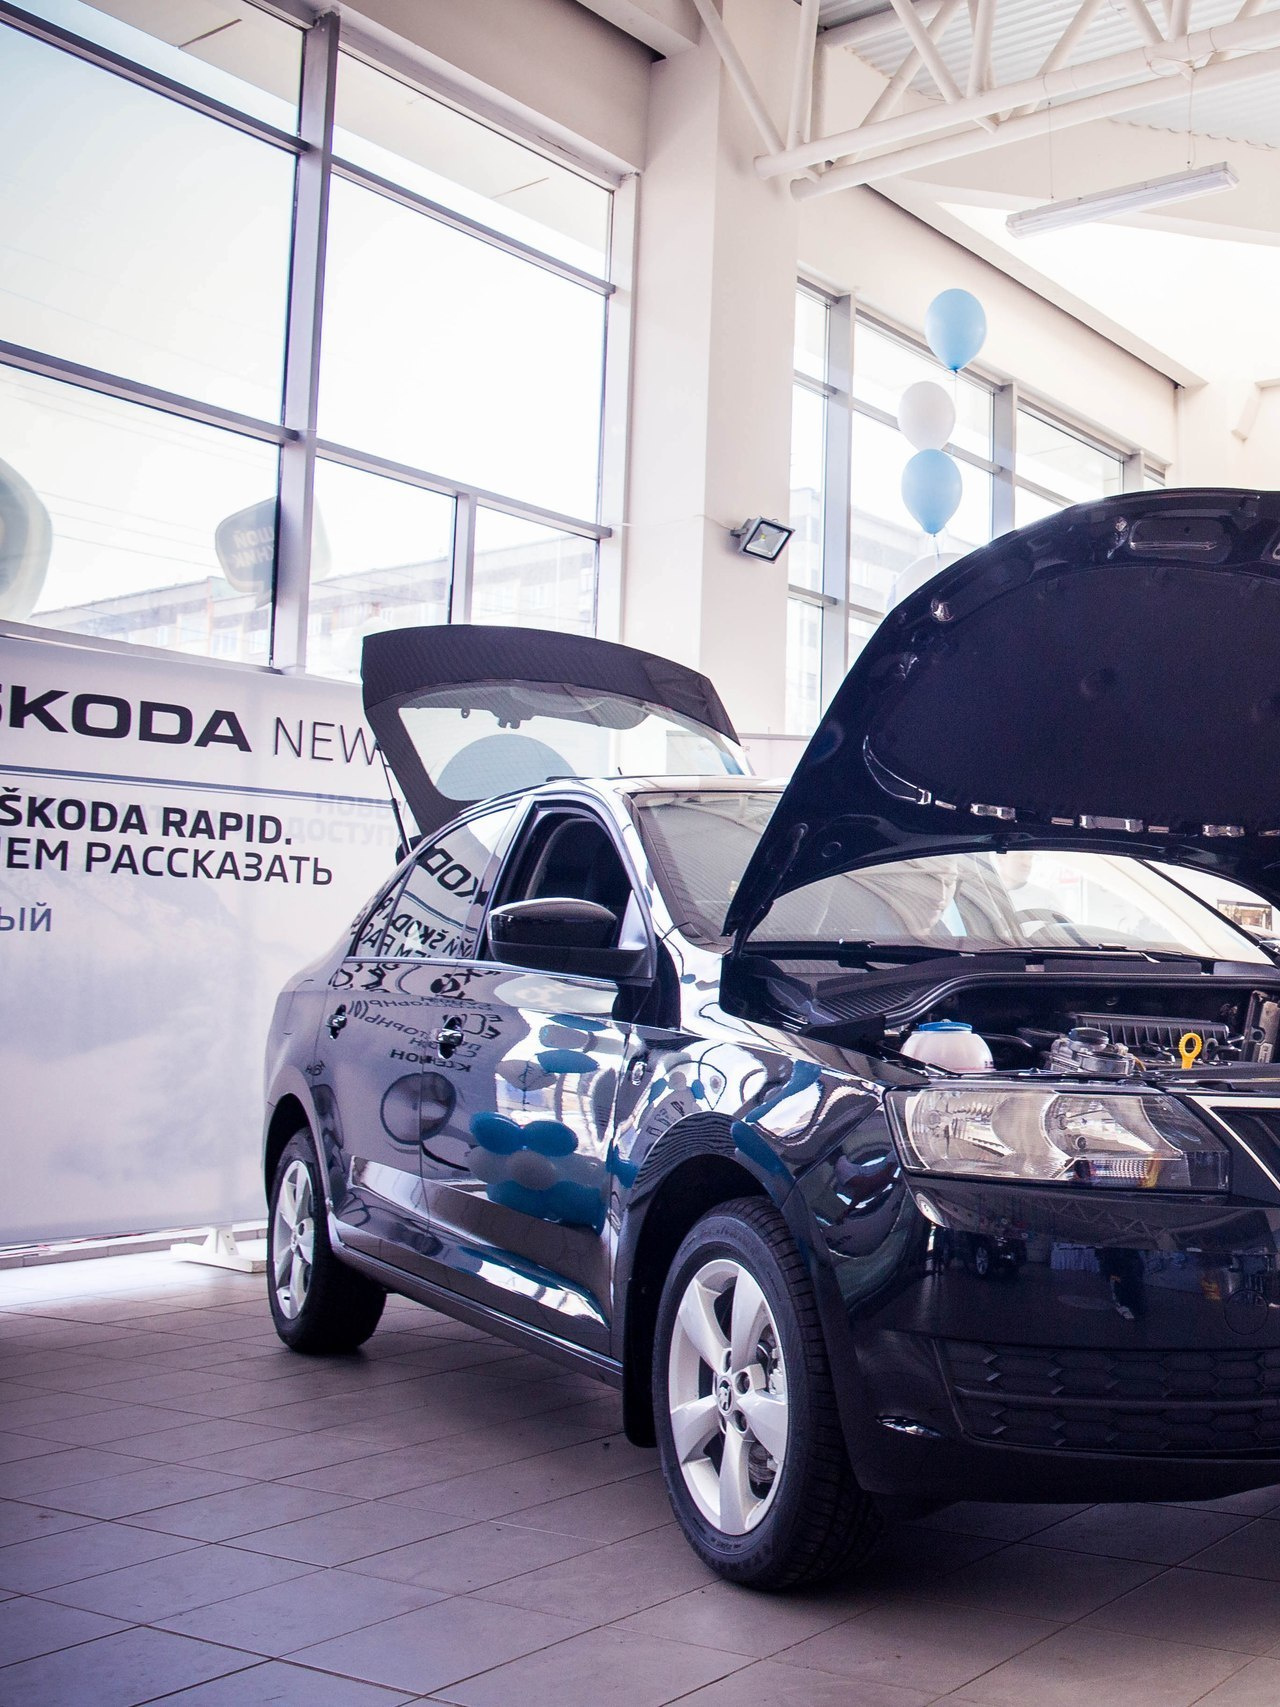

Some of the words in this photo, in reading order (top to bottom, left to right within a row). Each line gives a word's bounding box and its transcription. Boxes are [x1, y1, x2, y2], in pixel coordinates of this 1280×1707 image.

[0, 683, 252, 752] KODA
[274, 717, 379, 765] NEW
[0, 786, 147, 835] ŠKODA
[162, 807, 292, 845] RAPID.
[0, 837, 68, 871] ЕМ
[85, 842, 332, 886] РАССКАЗАТЬ
